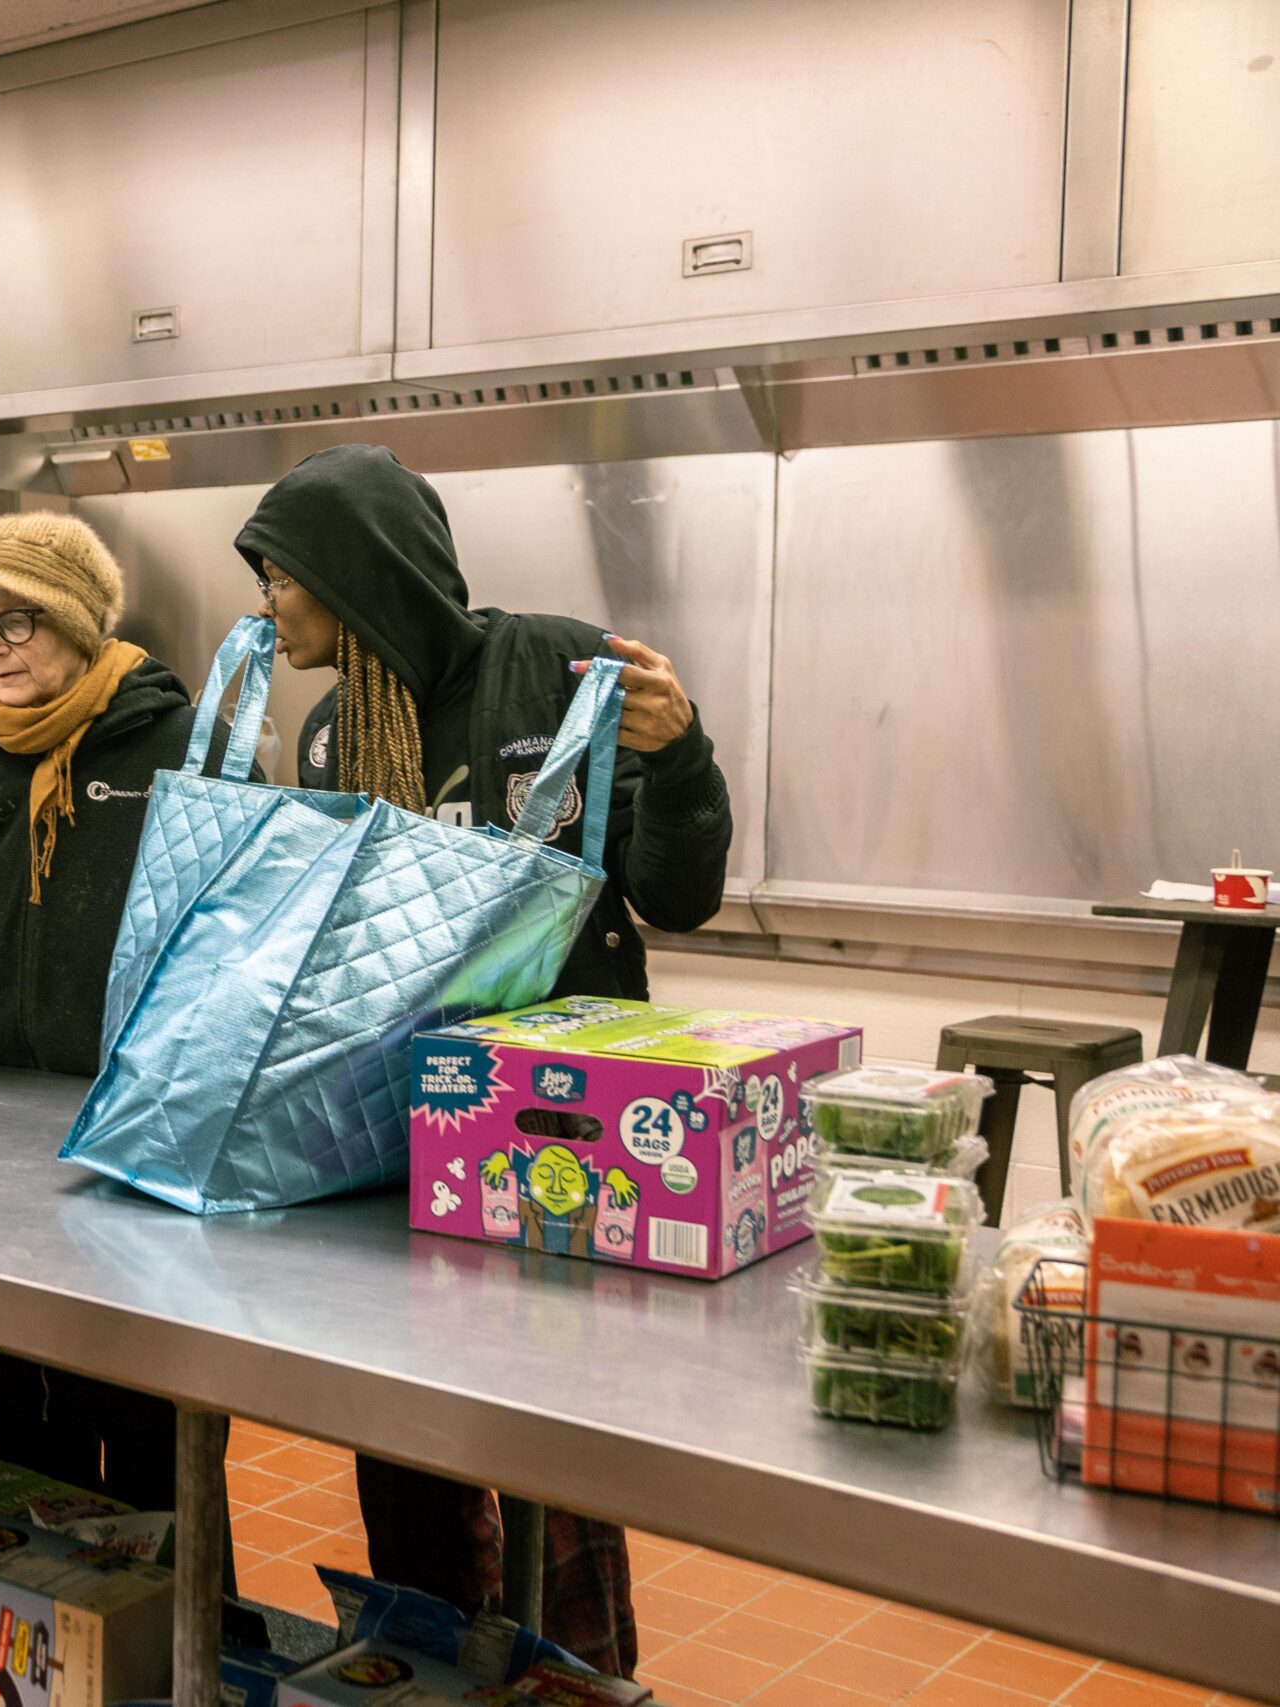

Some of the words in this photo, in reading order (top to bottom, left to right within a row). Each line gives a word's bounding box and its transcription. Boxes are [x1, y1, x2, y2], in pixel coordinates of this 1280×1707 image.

[499, 736, 556, 757] COMMAND
[426, 1056, 472, 1067] PERFECT
[437, 1065, 460, 1076] FOR
[420, 1073, 478, 1085] TRICK-OR-
[420, 1083, 478, 1094] TREATERS!
[761, 1081, 780, 1114] 24
[631, 1104, 673, 1138] 24
[632, 1136, 671, 1152] BAGS
[770, 1131, 820, 1190] POPC
